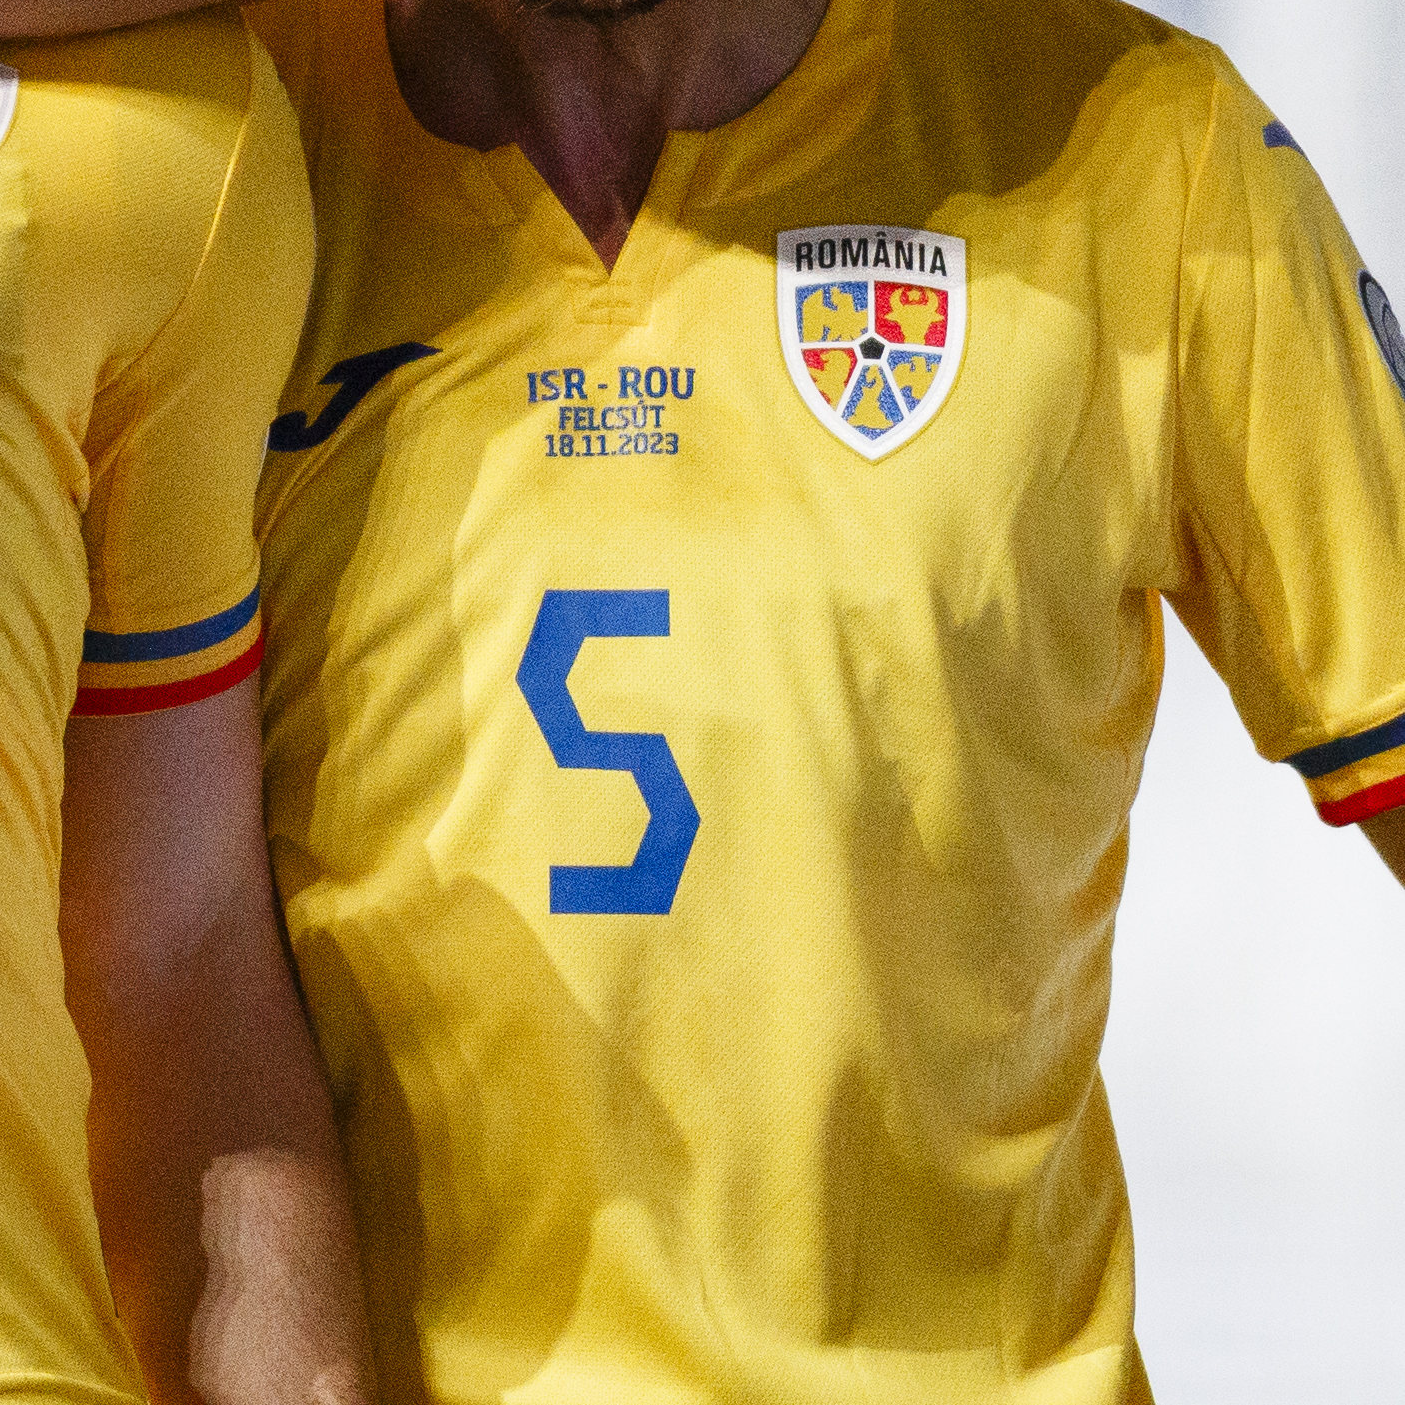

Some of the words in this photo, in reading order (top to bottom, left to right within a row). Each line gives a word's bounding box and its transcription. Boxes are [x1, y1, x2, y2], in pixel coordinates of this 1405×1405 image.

[795, 231, 948, 277] ROMÂNIA
[527, 367, 585, 403] ISR
[618, 366, 696, 400] ROU
[558, 400, 666, 431] FELCSÚT
[545, 432, 680, 458] 18.11.2023
[515, 588, 702, 915] 5
